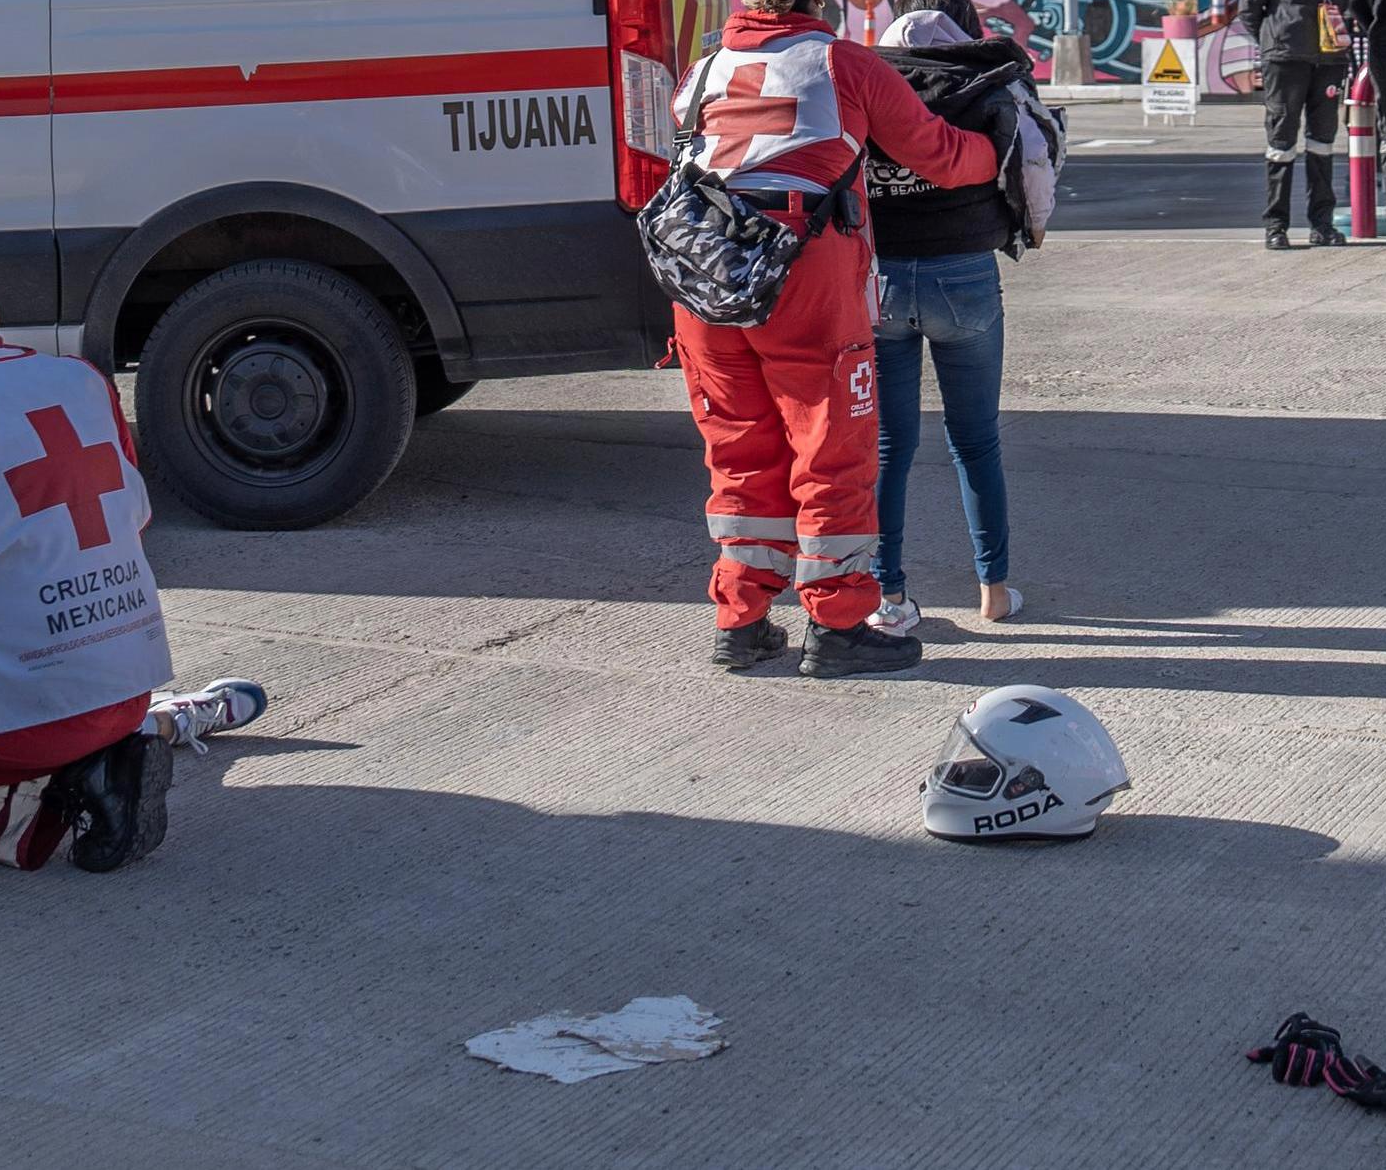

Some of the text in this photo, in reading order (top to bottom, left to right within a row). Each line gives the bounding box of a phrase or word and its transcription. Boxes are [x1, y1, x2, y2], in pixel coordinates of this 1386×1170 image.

[443, 95, 597, 152] TIJUANA
[39, 559, 141, 605] CRUZ ROJA
[46, 588, 148, 635] MEXICANA
[974, 793, 1064, 833] RODA
